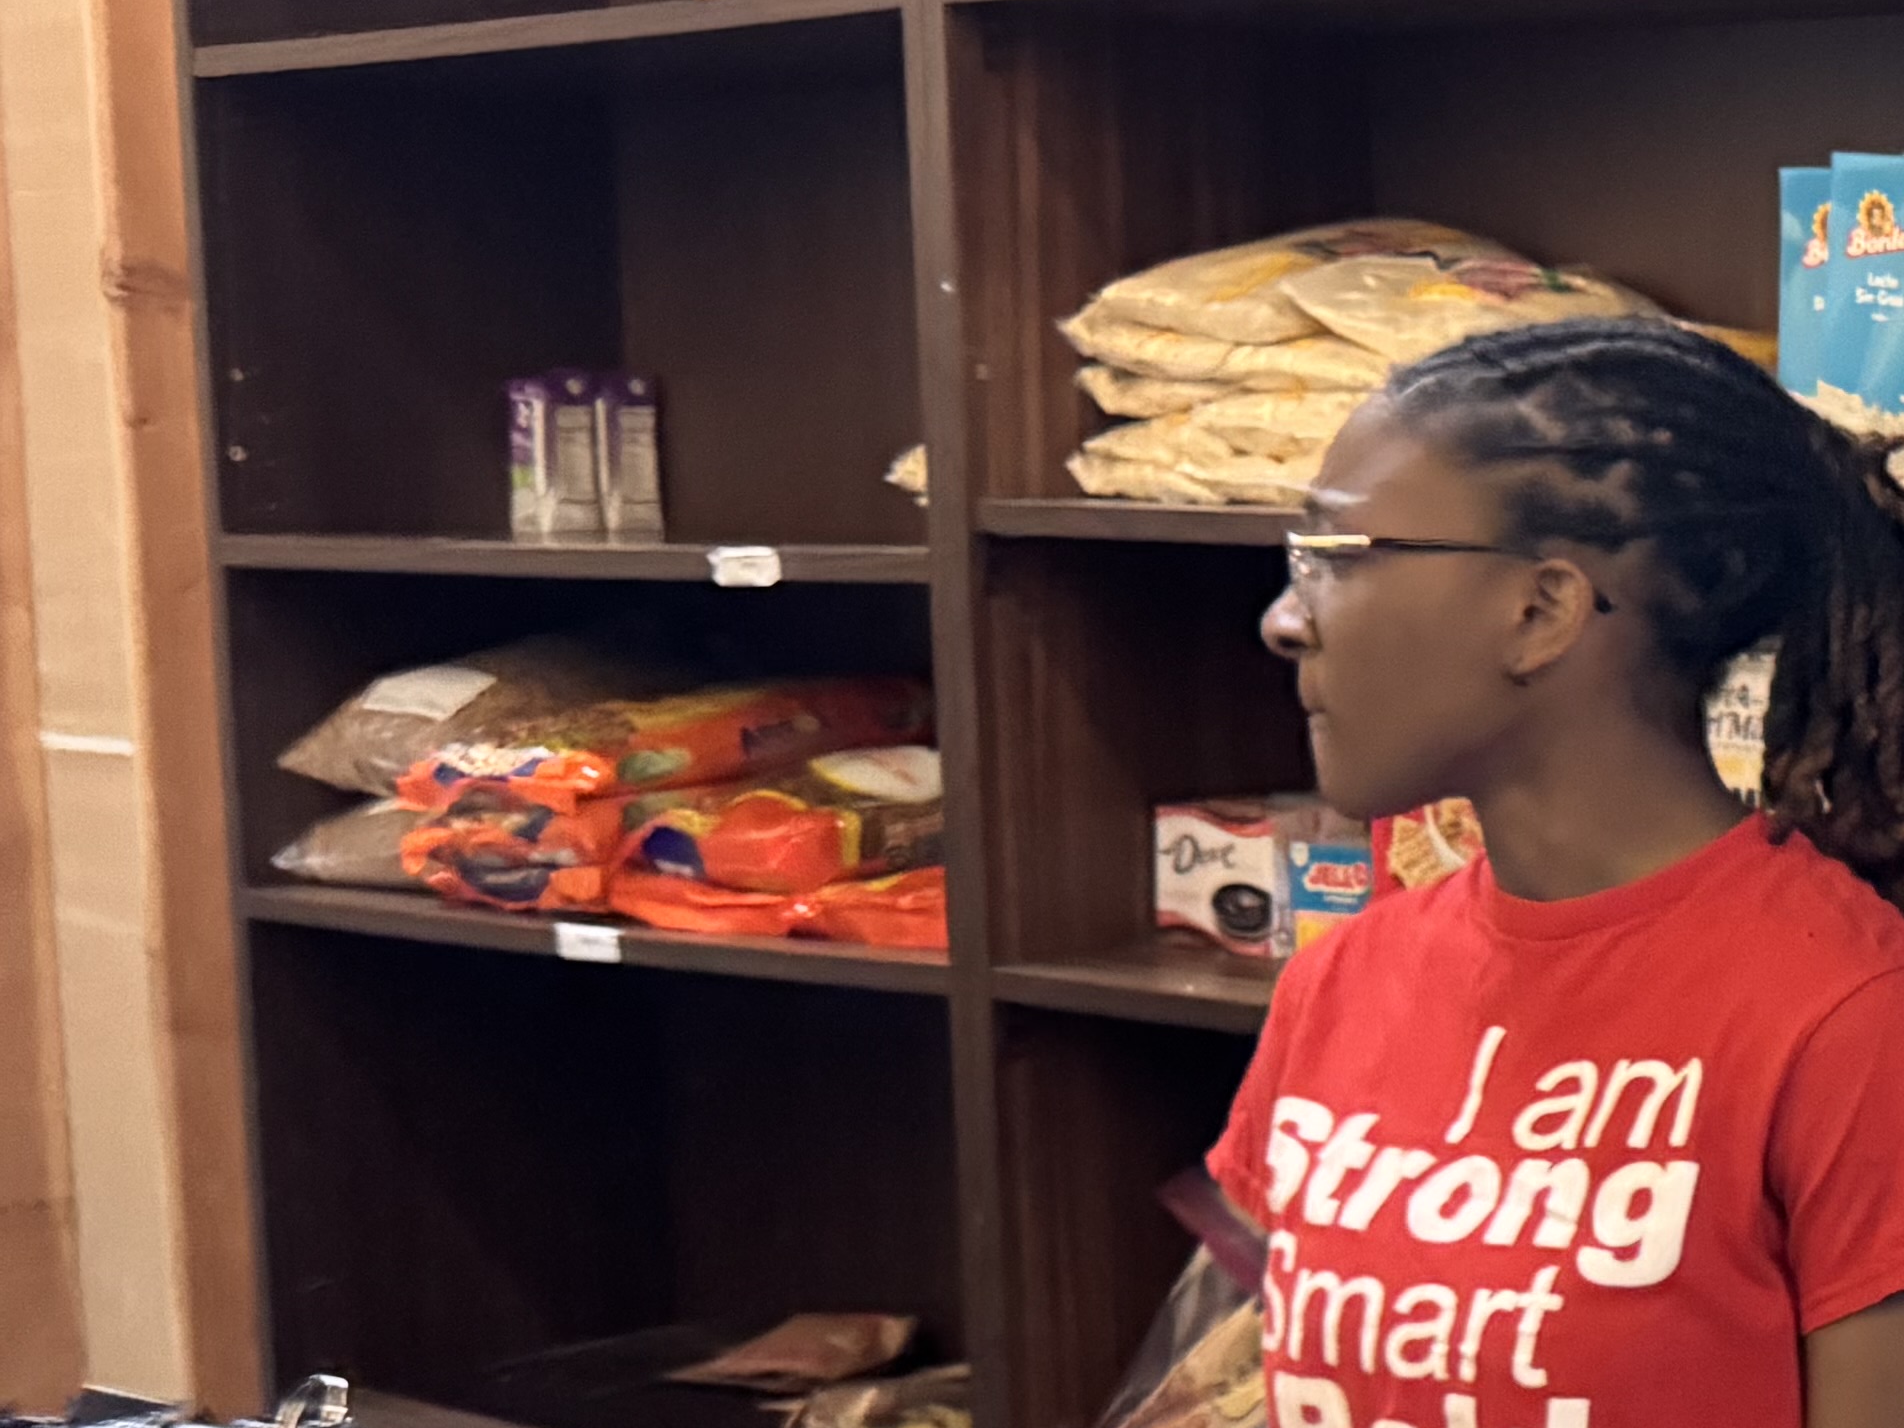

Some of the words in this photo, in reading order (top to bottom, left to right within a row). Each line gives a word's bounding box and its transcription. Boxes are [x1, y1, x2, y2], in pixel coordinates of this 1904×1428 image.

[1445, 1027, 1506, 1144] I
[1512, 1058, 1703, 1150] am
[1266, 1095, 1700, 1288] Strong
[1264, 1231, 1562, 1388] Smart
